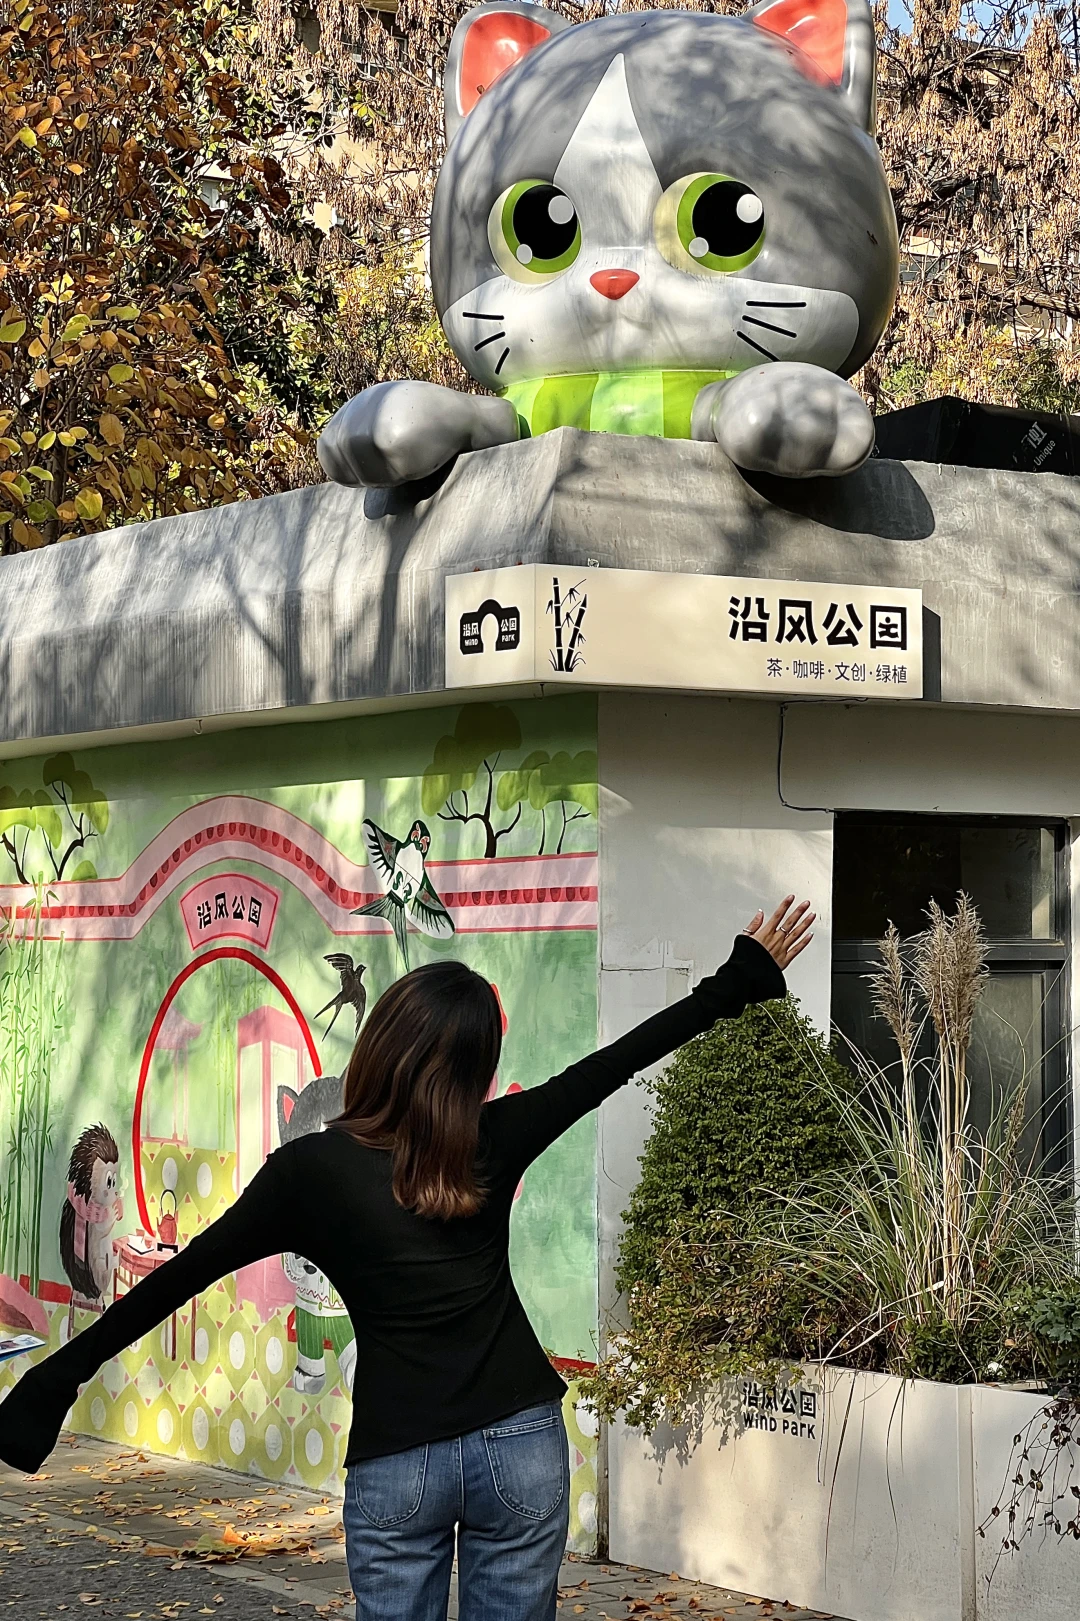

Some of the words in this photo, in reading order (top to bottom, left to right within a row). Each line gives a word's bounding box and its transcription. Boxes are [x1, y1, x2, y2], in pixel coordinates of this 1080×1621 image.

[1033, 440, 1056, 466] Unique
[462, 622, 480, 637] 沿风
[500, 617, 517, 633] 公园
[728, 596, 908, 651] 沿风公园
[196, 891, 263, 930] 沿风公园
[743, 1381, 817, 1420] 沿风公园
